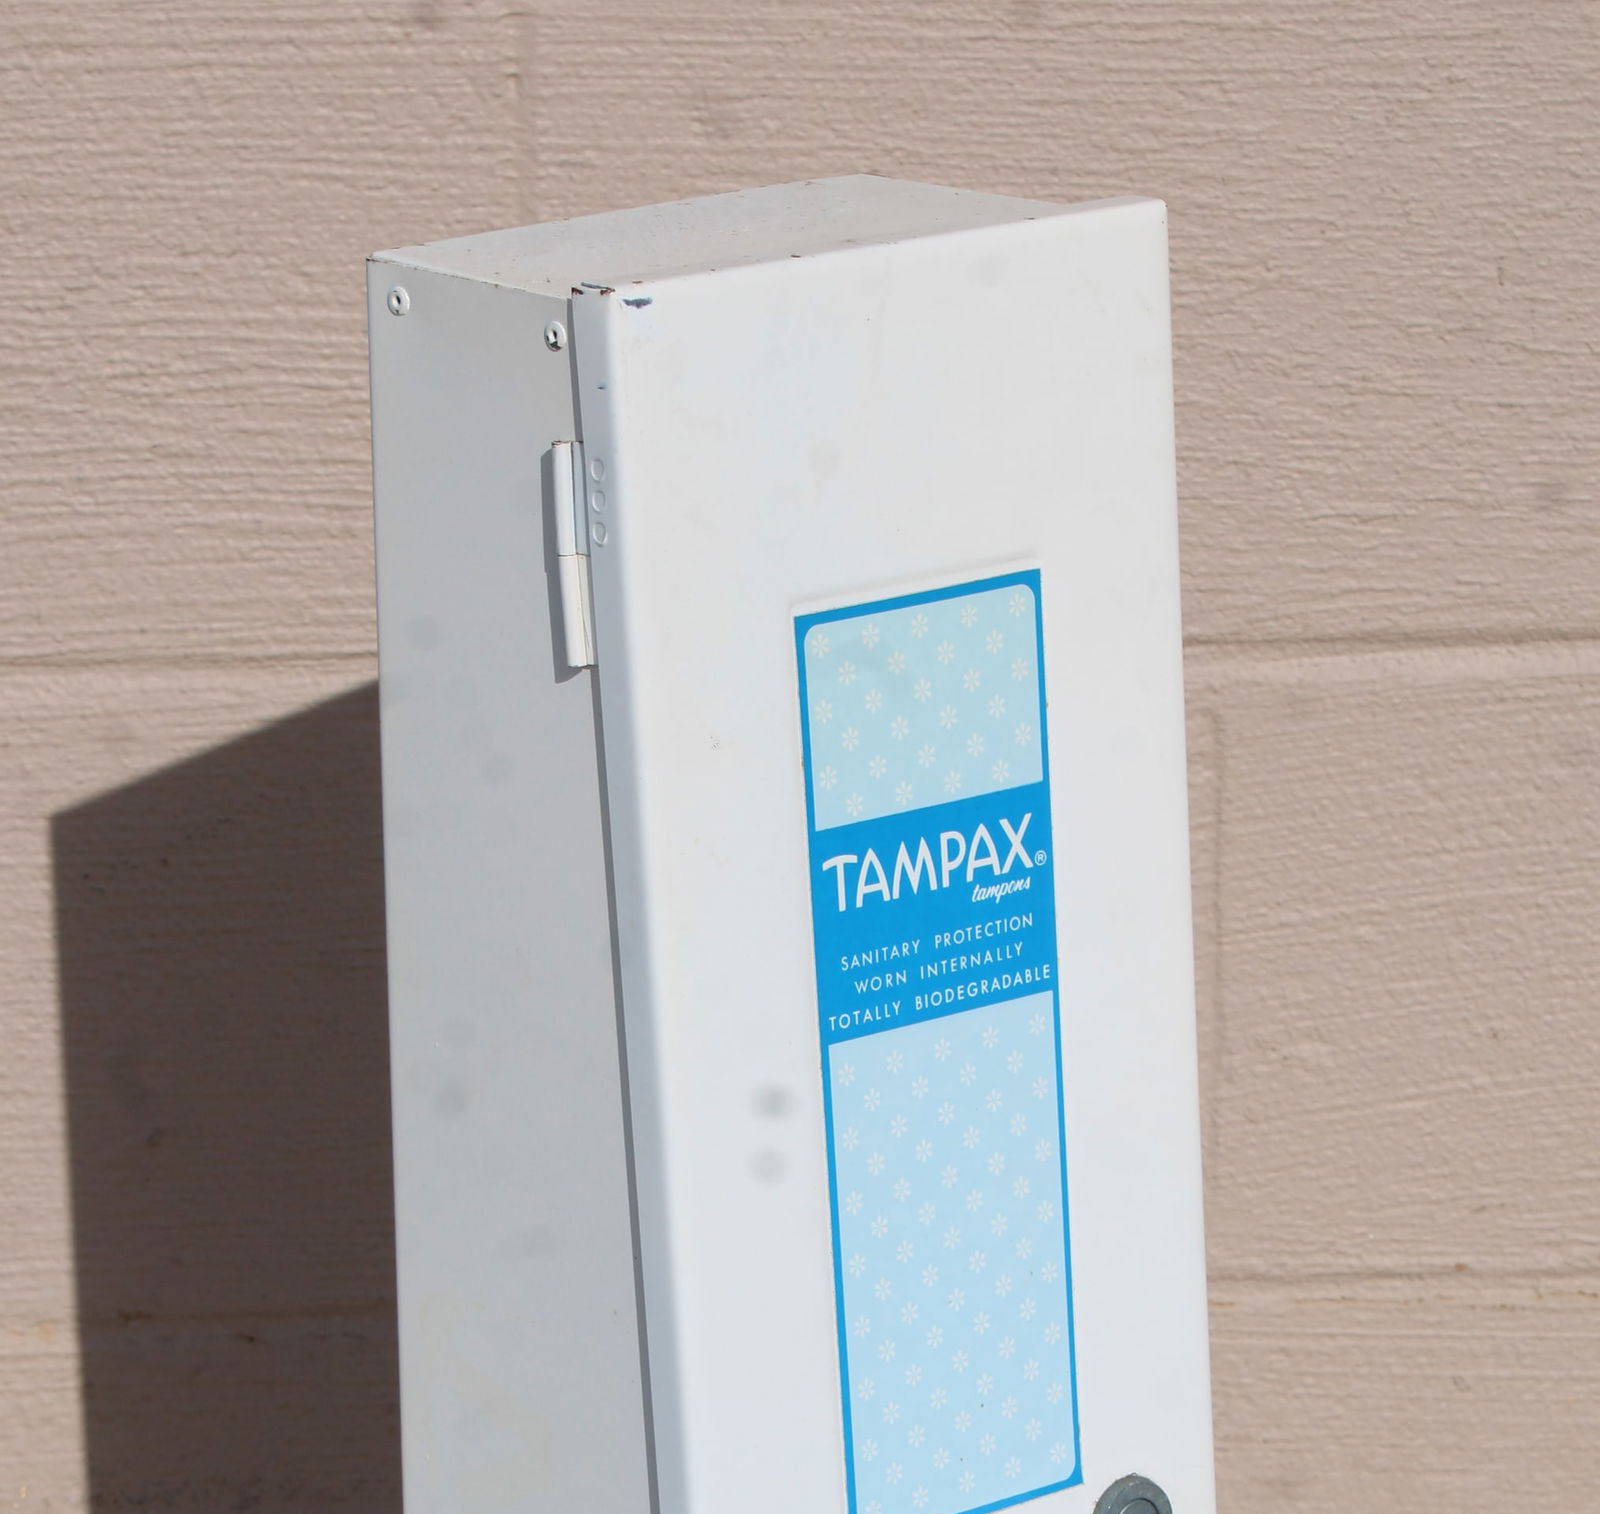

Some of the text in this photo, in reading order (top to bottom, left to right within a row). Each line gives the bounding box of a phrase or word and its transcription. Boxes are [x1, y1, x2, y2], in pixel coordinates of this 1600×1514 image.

[971, 876, 1031, 904] tampons
[841, 912, 1034, 971] SANITARY PROTECTION
[854, 941, 1023, 995] WORN INTERNALLY
[829, 964, 1050, 1031] TOTALLY BIODEGRADABLE
